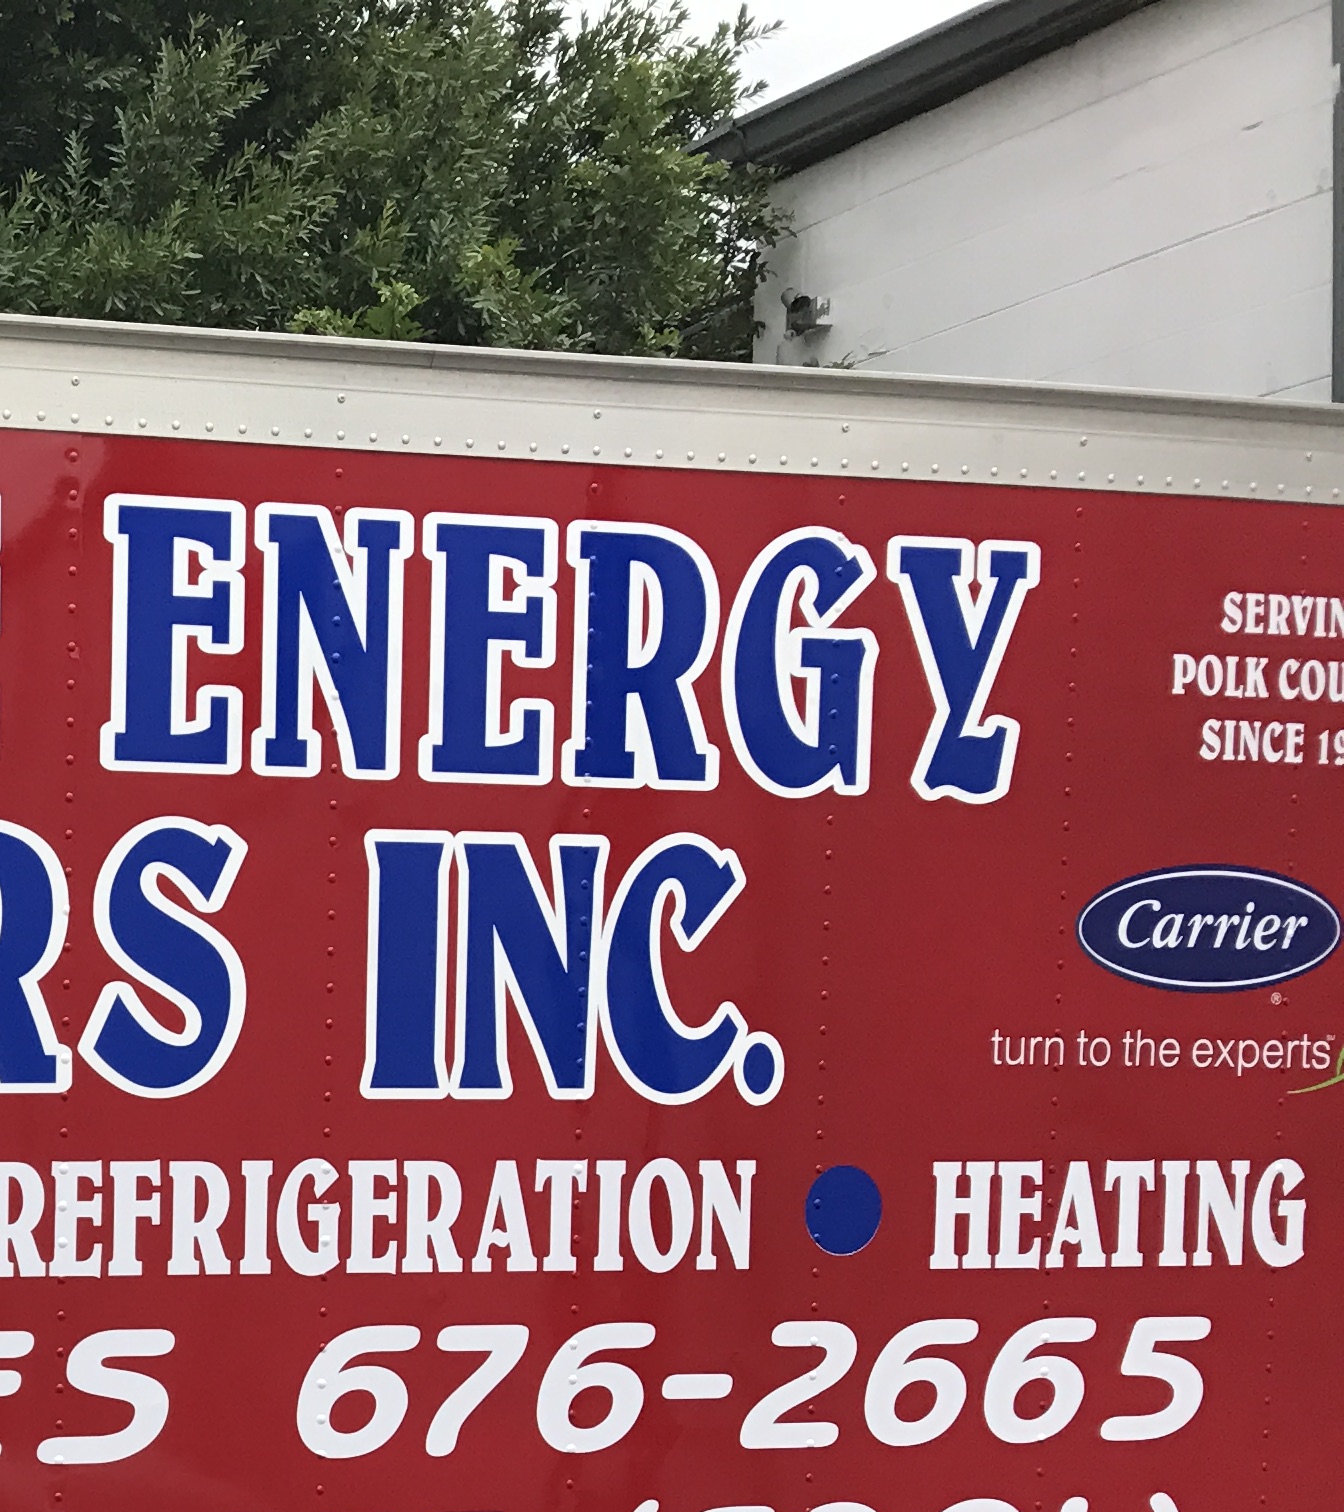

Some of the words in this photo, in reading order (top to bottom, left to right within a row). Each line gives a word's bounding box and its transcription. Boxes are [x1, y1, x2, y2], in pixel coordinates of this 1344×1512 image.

[100, 493, 1041, 804] ENERGY
[1172, 654, 1268, 698] POLK
[1199, 719, 1304, 763] SINCE
[1118, 900, 1308, 950] Carrier
[359, 829, 784, 1106] INC.
[992, 1030, 1064, 1065] turn
[1077, 1031, 1110, 1066] to
[1123, 1030, 1180, 1067] the
[1192, 1034, 1330, 1076] experts
[930, 1159, 1306, 1269] HEATING
[297, 1317, 1211, 1458] 676-2665
